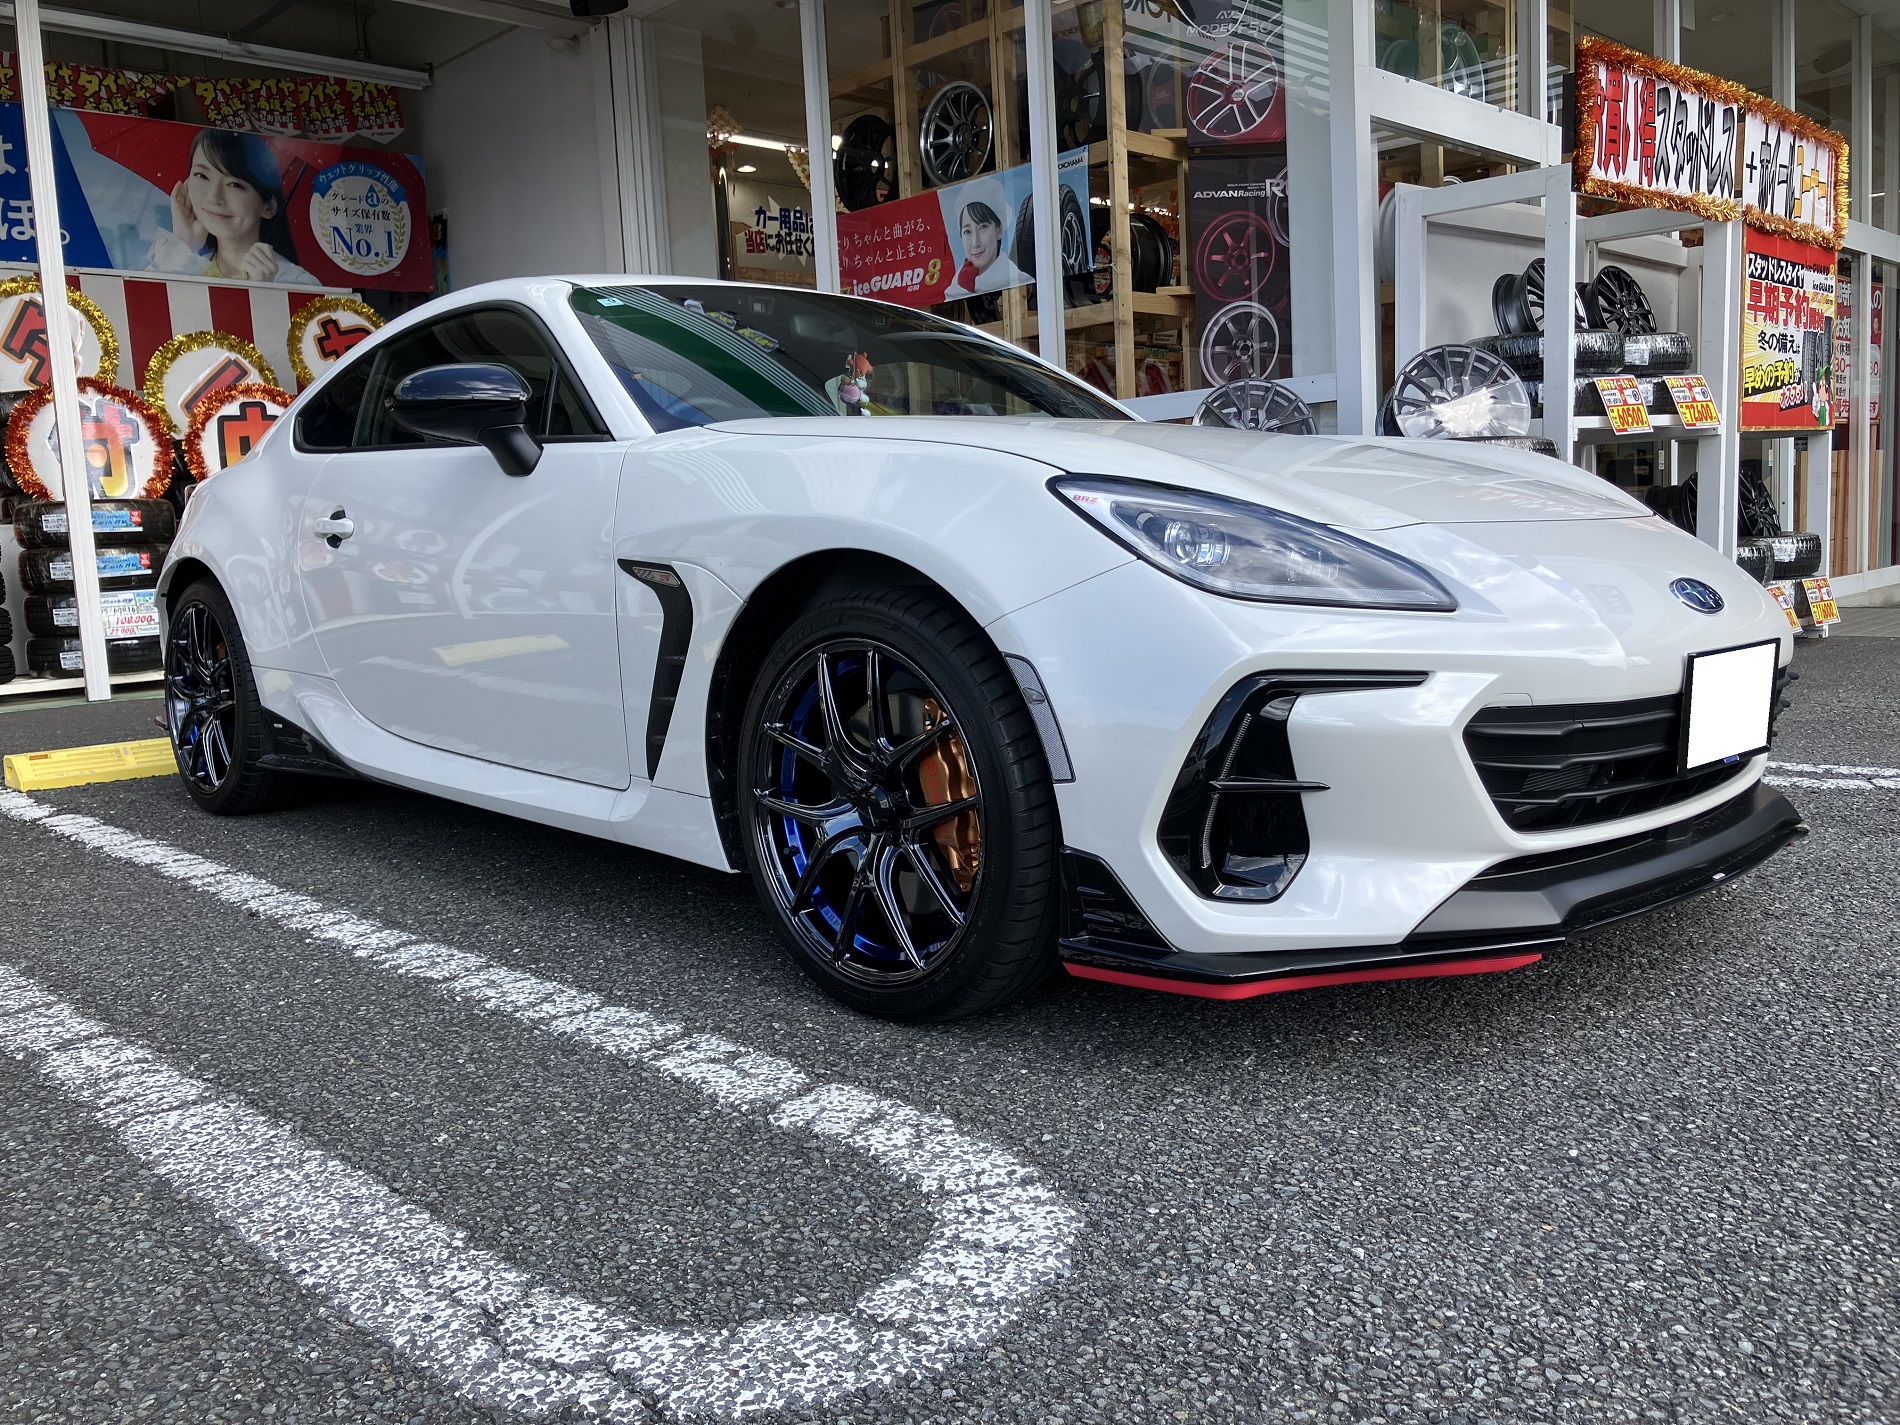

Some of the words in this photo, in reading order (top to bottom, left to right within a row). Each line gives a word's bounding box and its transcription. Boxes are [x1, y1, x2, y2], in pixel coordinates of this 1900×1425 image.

[1058, 157, 1084, 169] OKOHAMA
[331, 206, 391, 221] サイズ保有数
[354, 223, 374, 235] 業界
[329, 225, 397, 259] No.1
[852, 267, 925, 297] iceGUARD
[924, 258, 943, 286] 8
[1748, 254, 1805, 288] スタッドレスタイヤ
[1757, 330, 1801, 355] 冬の備えは
[1744, 358, 1801, 393] 早めの予約が
[1072, 494, 1099, 503] BRZ
